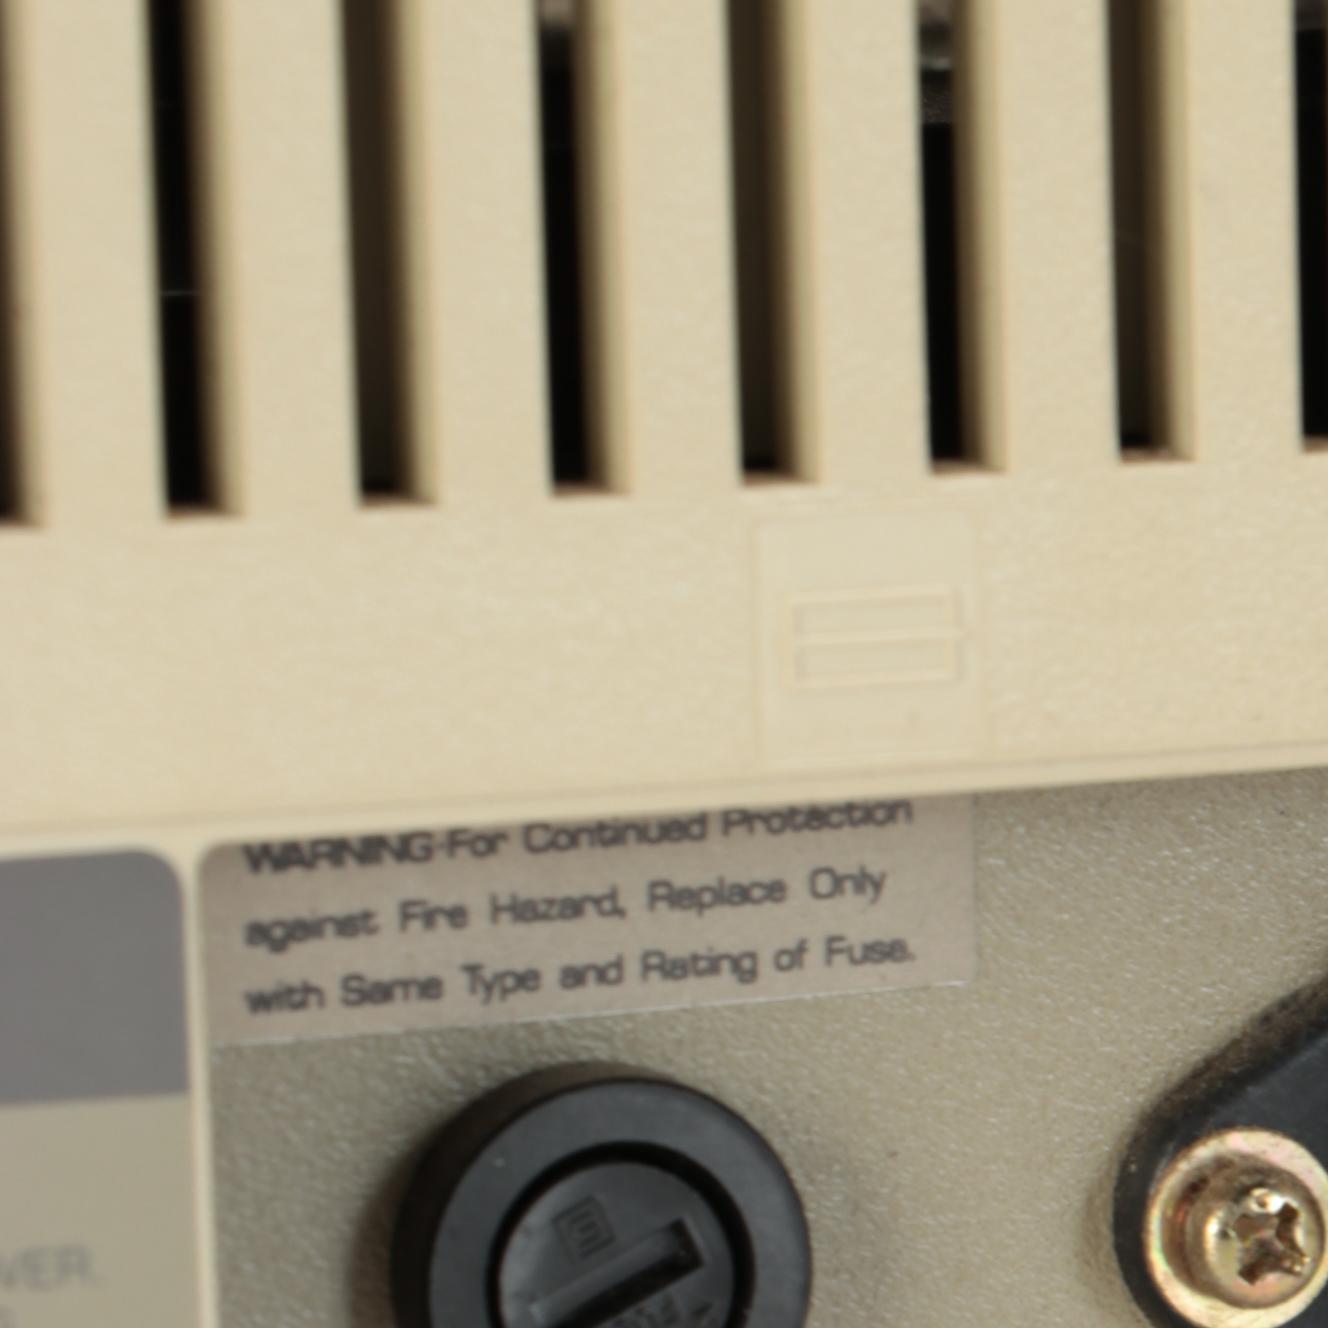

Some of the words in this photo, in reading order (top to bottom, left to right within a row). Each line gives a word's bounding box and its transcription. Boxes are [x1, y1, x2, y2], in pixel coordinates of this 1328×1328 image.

[521, 816, 708, 854] Continued
[719, 800, 914, 836] Protection
[244, 909, 379, 954] against
[398, 901, 469, 934] Fire
[490, 889, 627, 924] Hazard,
[647, 876, 788, 917] Replace
[808, 866, 888, 905] Only
[245, 980, 326, 1014] with
[341, 973, 444, 1007] Same
[460, 963, 543, 1006] Type
[560, 955, 625, 990] and
[640, 947, 760, 985] Rating
[773, 938, 808, 973] of
[825, 935, 916, 967] Fuse.
